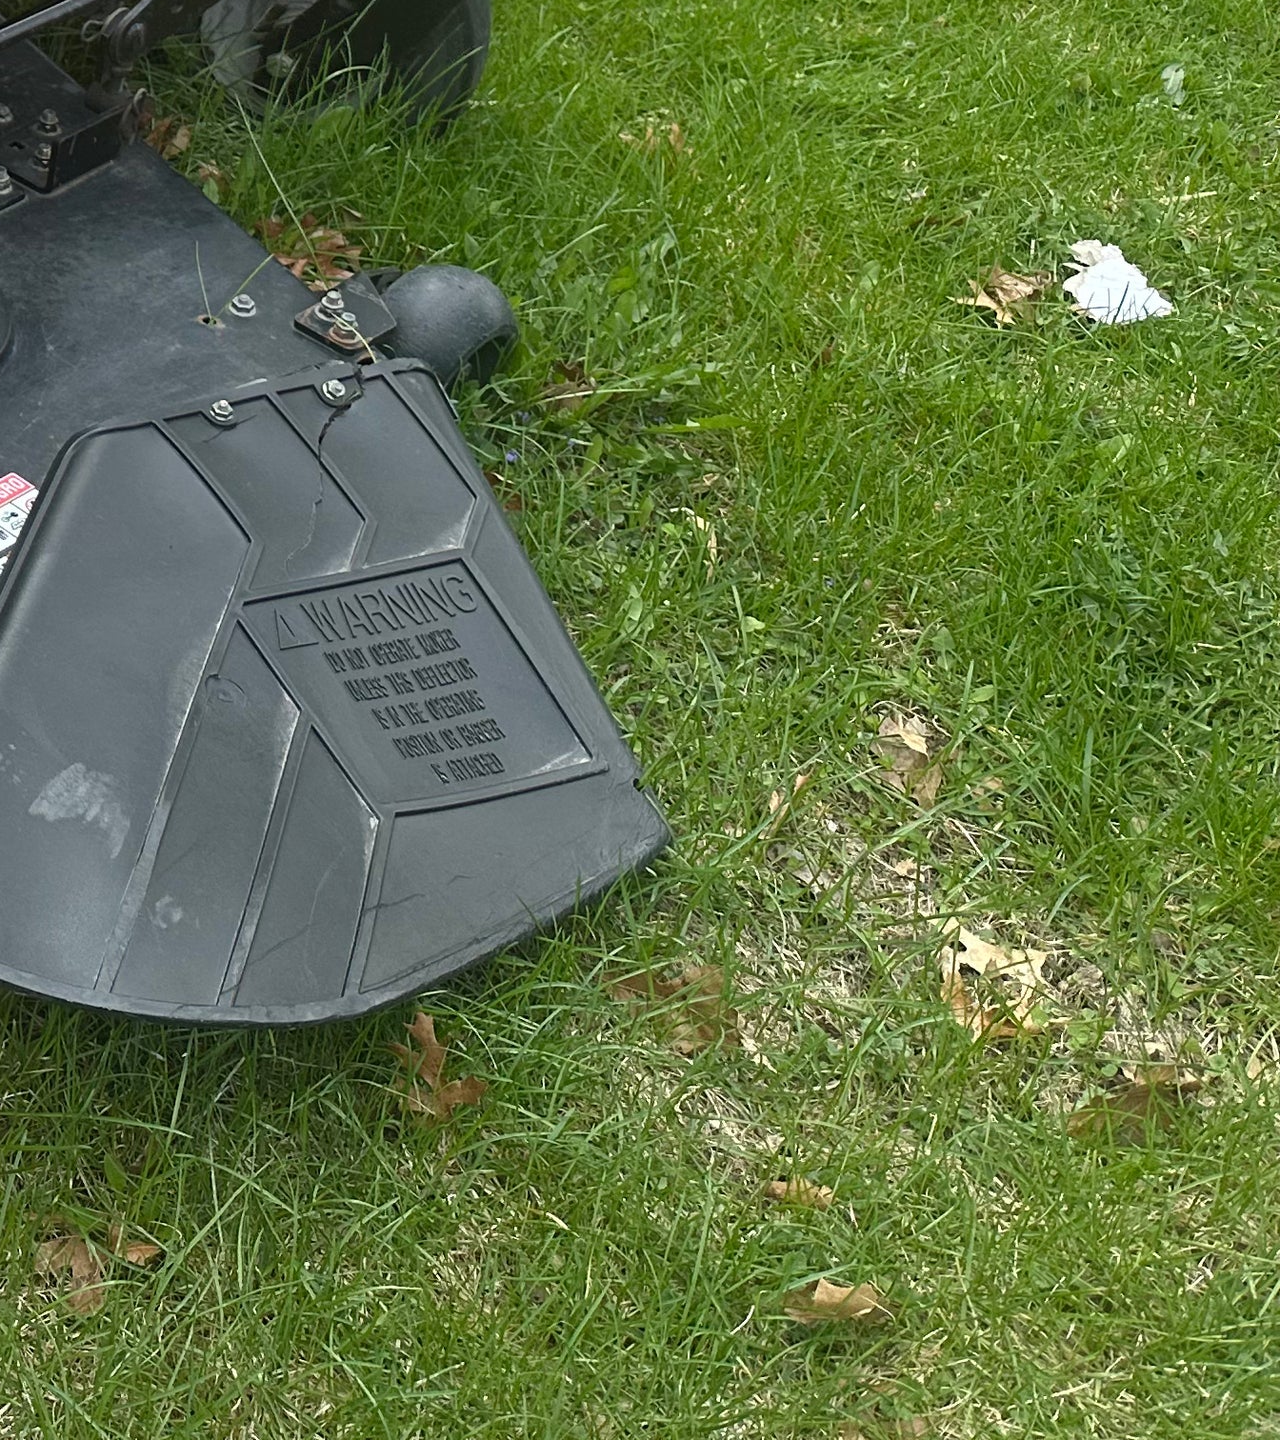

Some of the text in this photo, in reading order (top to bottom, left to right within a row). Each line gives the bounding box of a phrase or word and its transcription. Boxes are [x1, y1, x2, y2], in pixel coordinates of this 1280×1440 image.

[300, 574, 479, 643] WARNING
[368, 637, 422, 666] OPERATE
[344, 657, 478, 702] UNLESS THIS DEFLECTOR
[372, 708, 390, 729] IS
[399, 702, 430, 725] THE
[424, 689, 486, 721] OPERATING
[446, 752, 505, 781] ATTACHED
